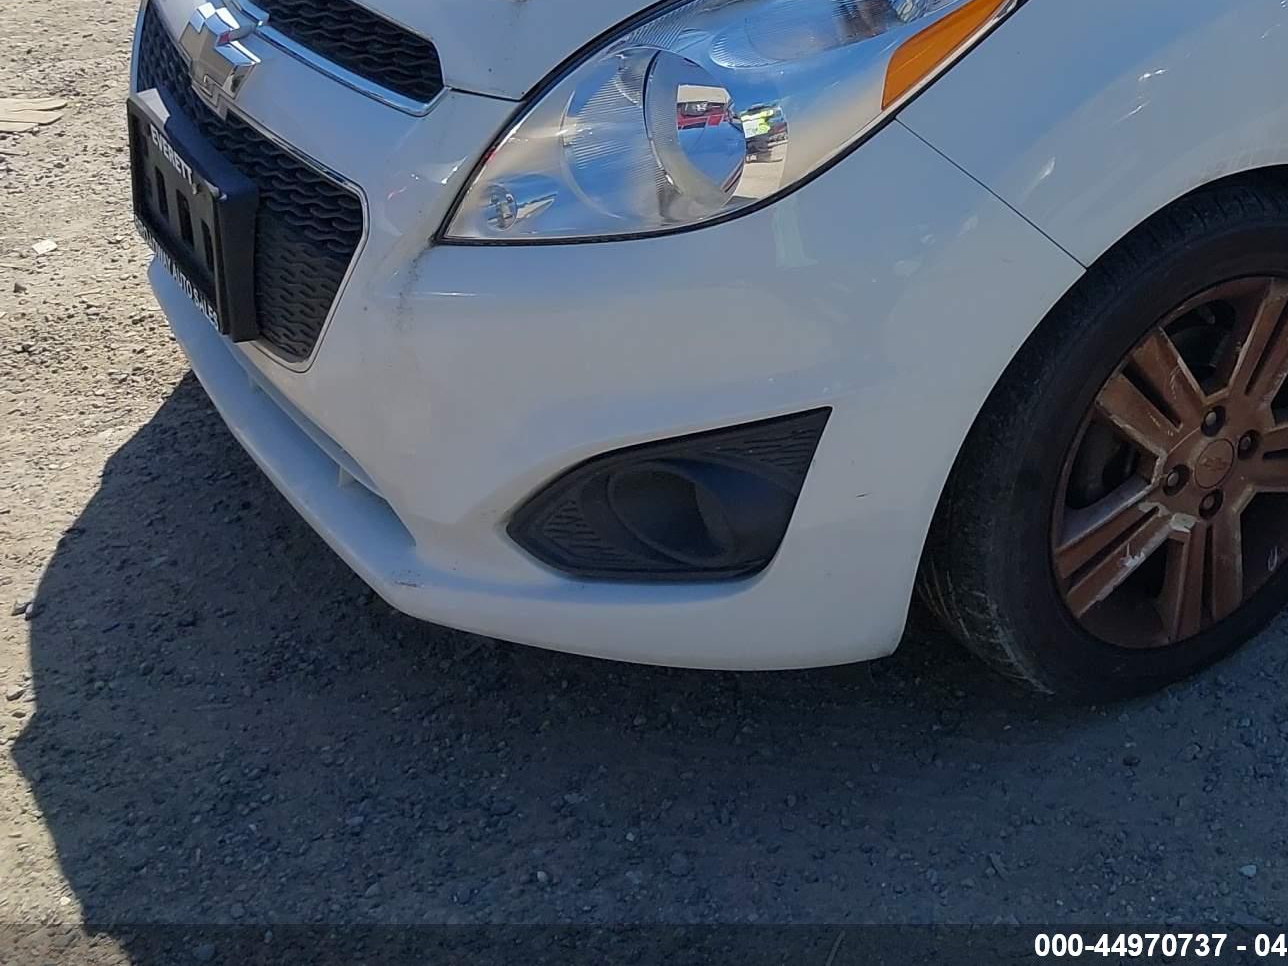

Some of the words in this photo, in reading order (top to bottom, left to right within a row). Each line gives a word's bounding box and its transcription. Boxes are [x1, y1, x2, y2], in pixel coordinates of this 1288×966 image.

[150, 123, 193, 184] EVERETT
[172, 263, 193, 299] AUTO
[193, 288, 219, 332] SALES
